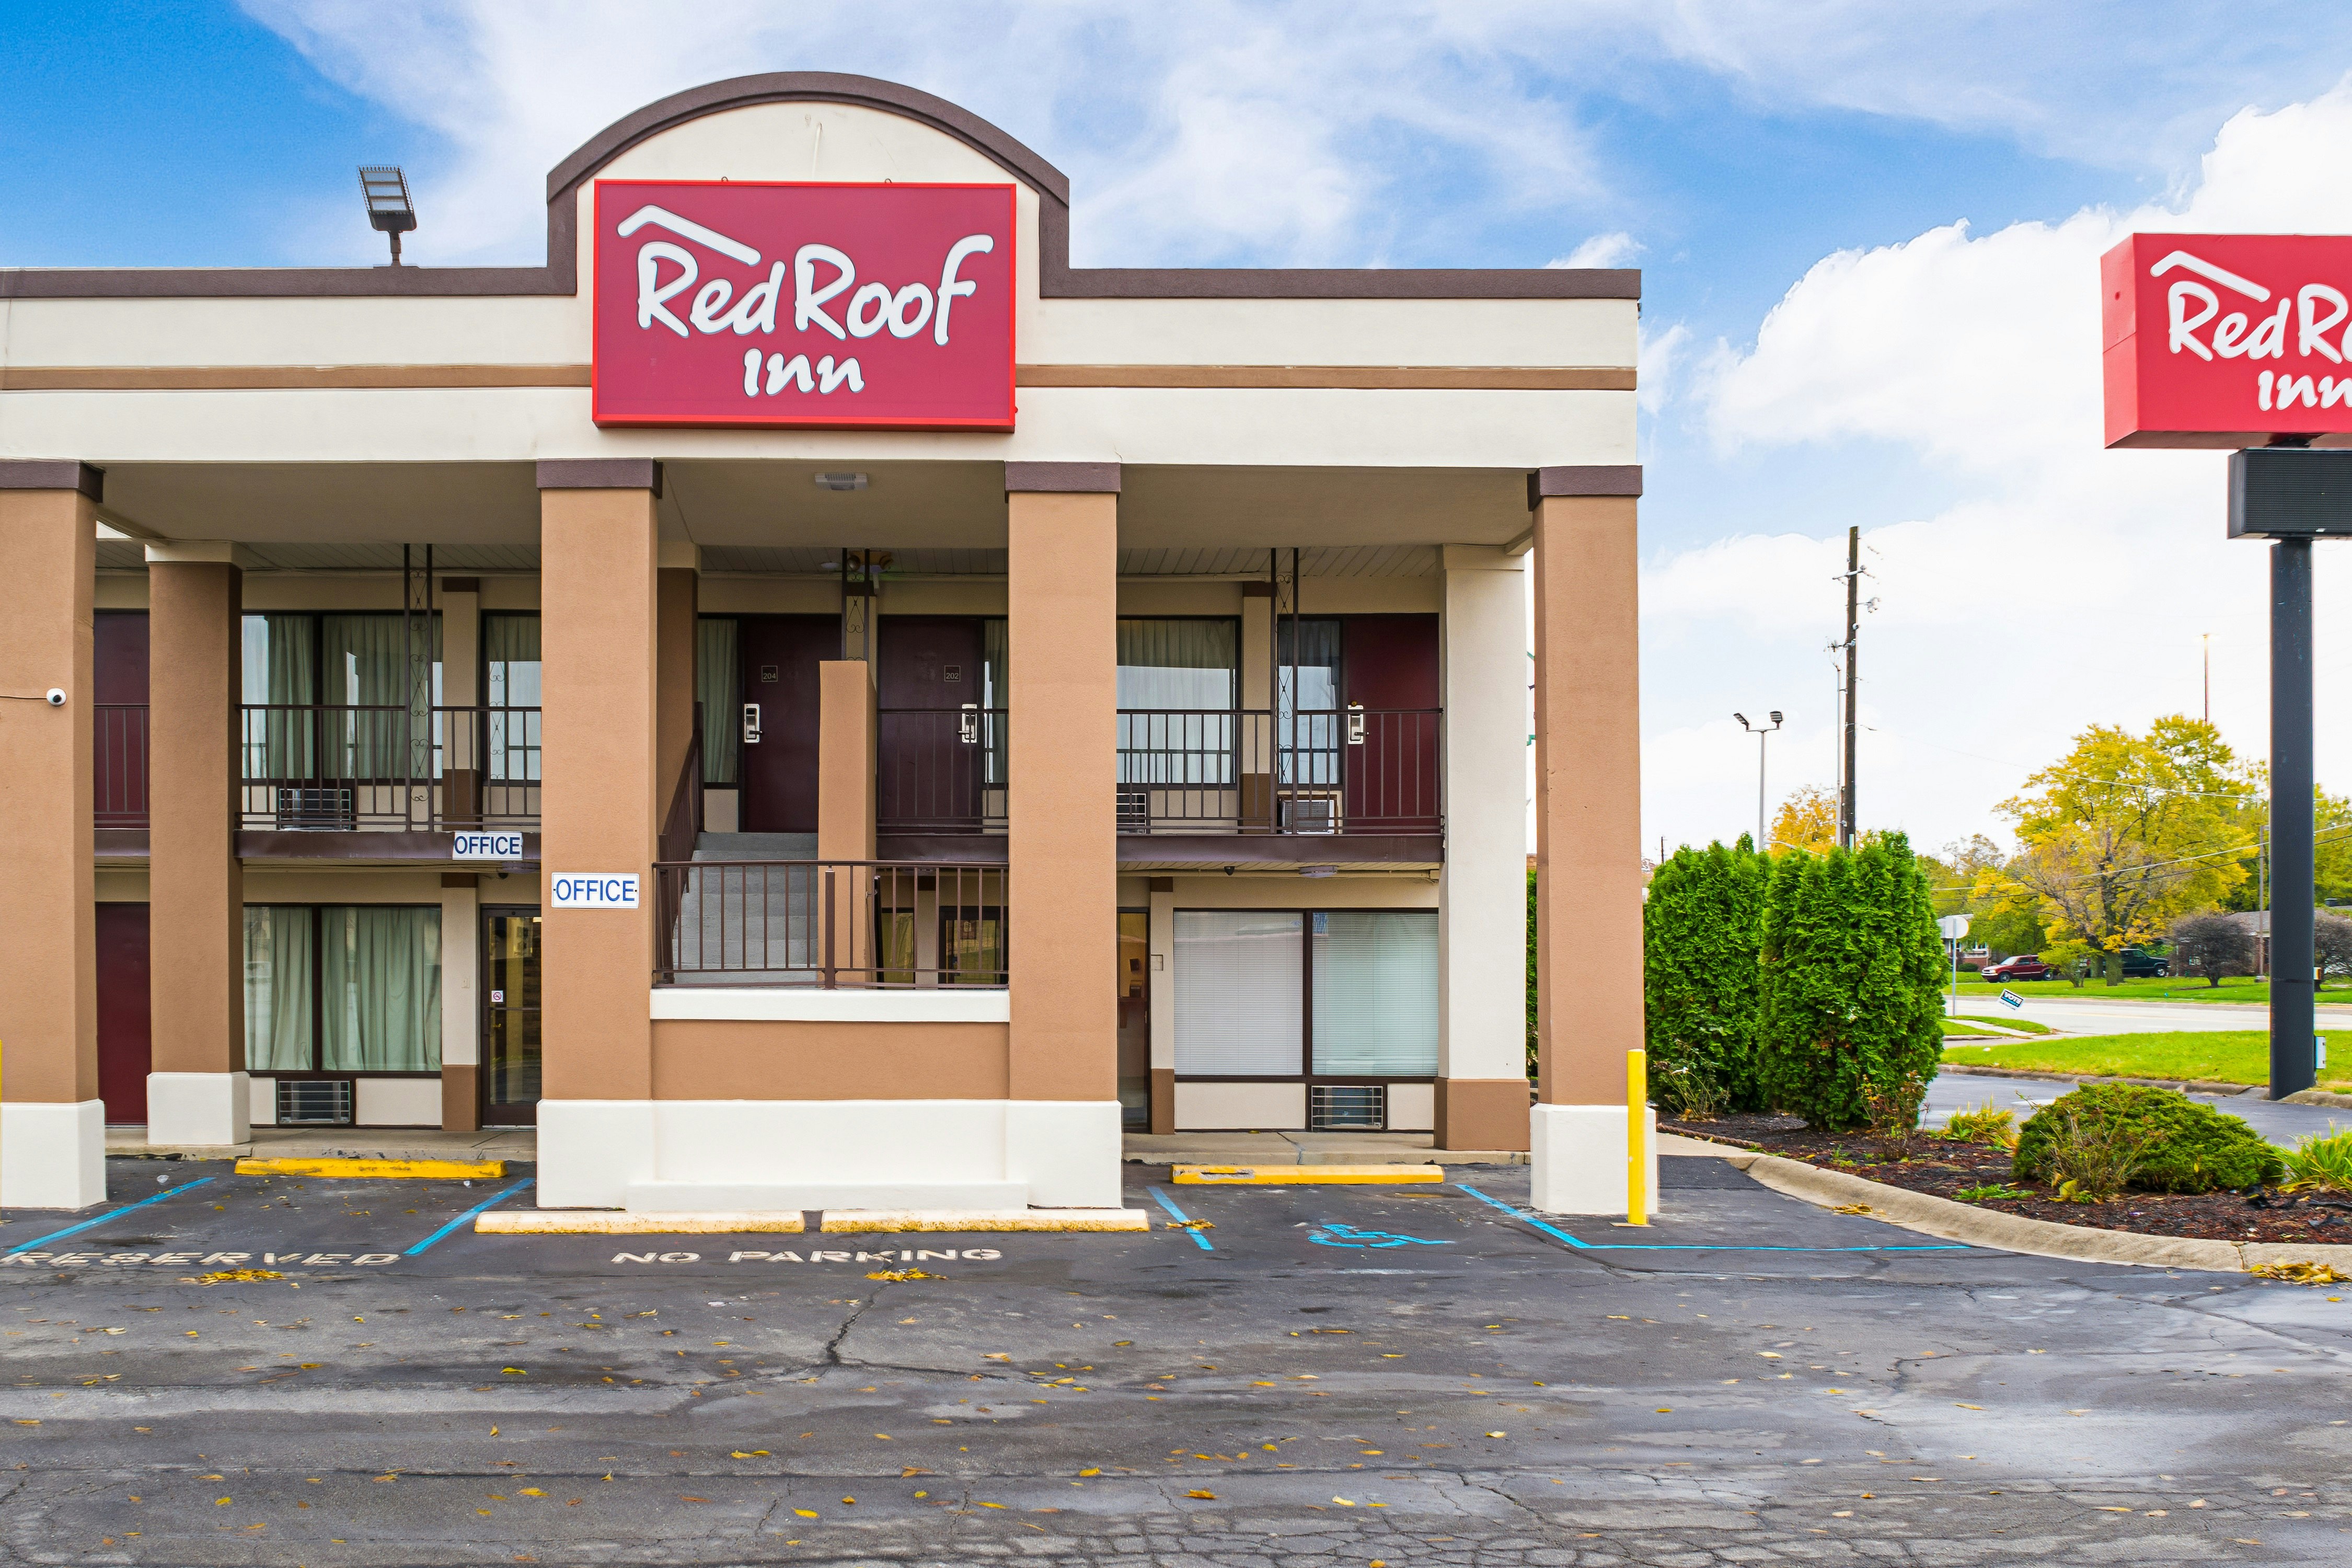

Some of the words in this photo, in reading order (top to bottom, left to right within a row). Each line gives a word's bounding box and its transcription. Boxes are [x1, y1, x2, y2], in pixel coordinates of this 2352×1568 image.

[637, 241, 786, 336] Red
[794, 234, 994, 347] Roof
[2168, 281, 2291, 362] Red
[743, 348, 866, 397] Inn
[454, 836, 521, 855] OFFICE
[556, 879, 635, 902] OFFICE
[0, 1251, 400, 1266] RESERVED
[610, 1252, 701, 1264] NO
[728, 1249, 1004, 1263] PARKING
